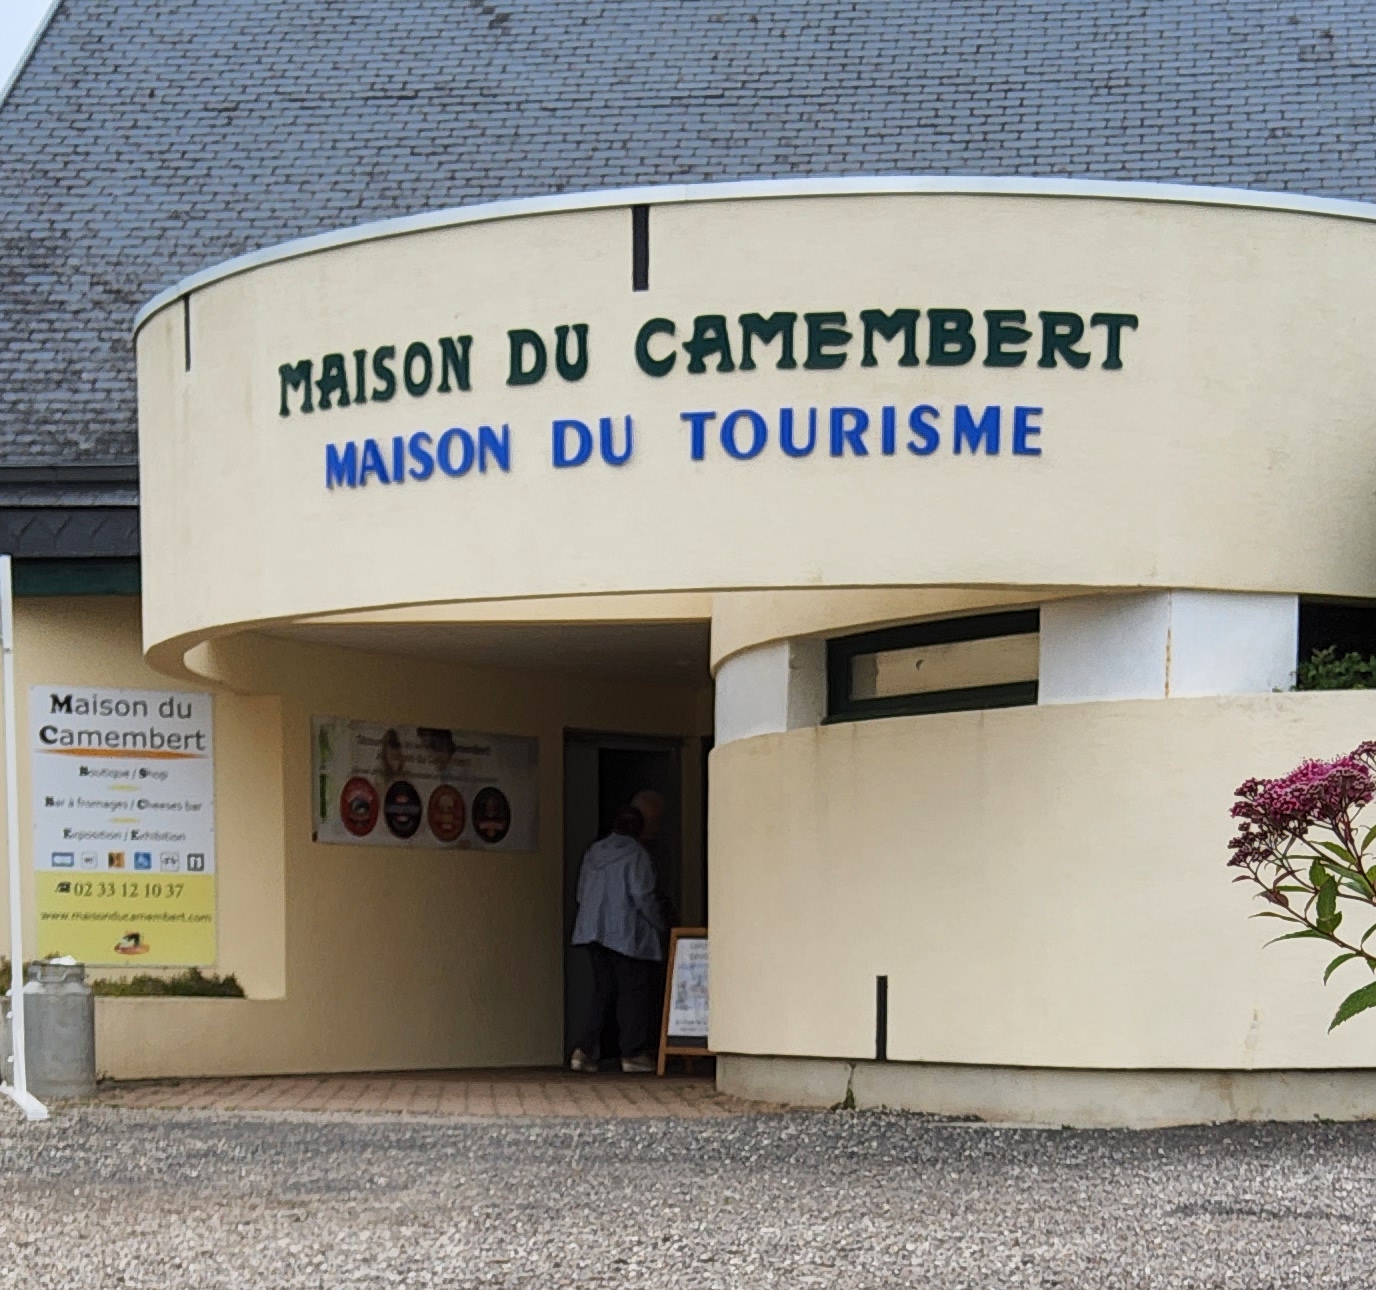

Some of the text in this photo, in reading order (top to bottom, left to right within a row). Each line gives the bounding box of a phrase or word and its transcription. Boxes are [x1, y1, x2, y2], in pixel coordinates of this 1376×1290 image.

[278, 308, 1139, 417] MAISON DU CAMEMBERT
[325, 403, 1044, 489] MAISON DU TOURISME
[50, 693, 192, 719] Maison du
[39, 725, 207, 750] Camembert
[74, 881, 185, 899] 02 33 12 10 37
